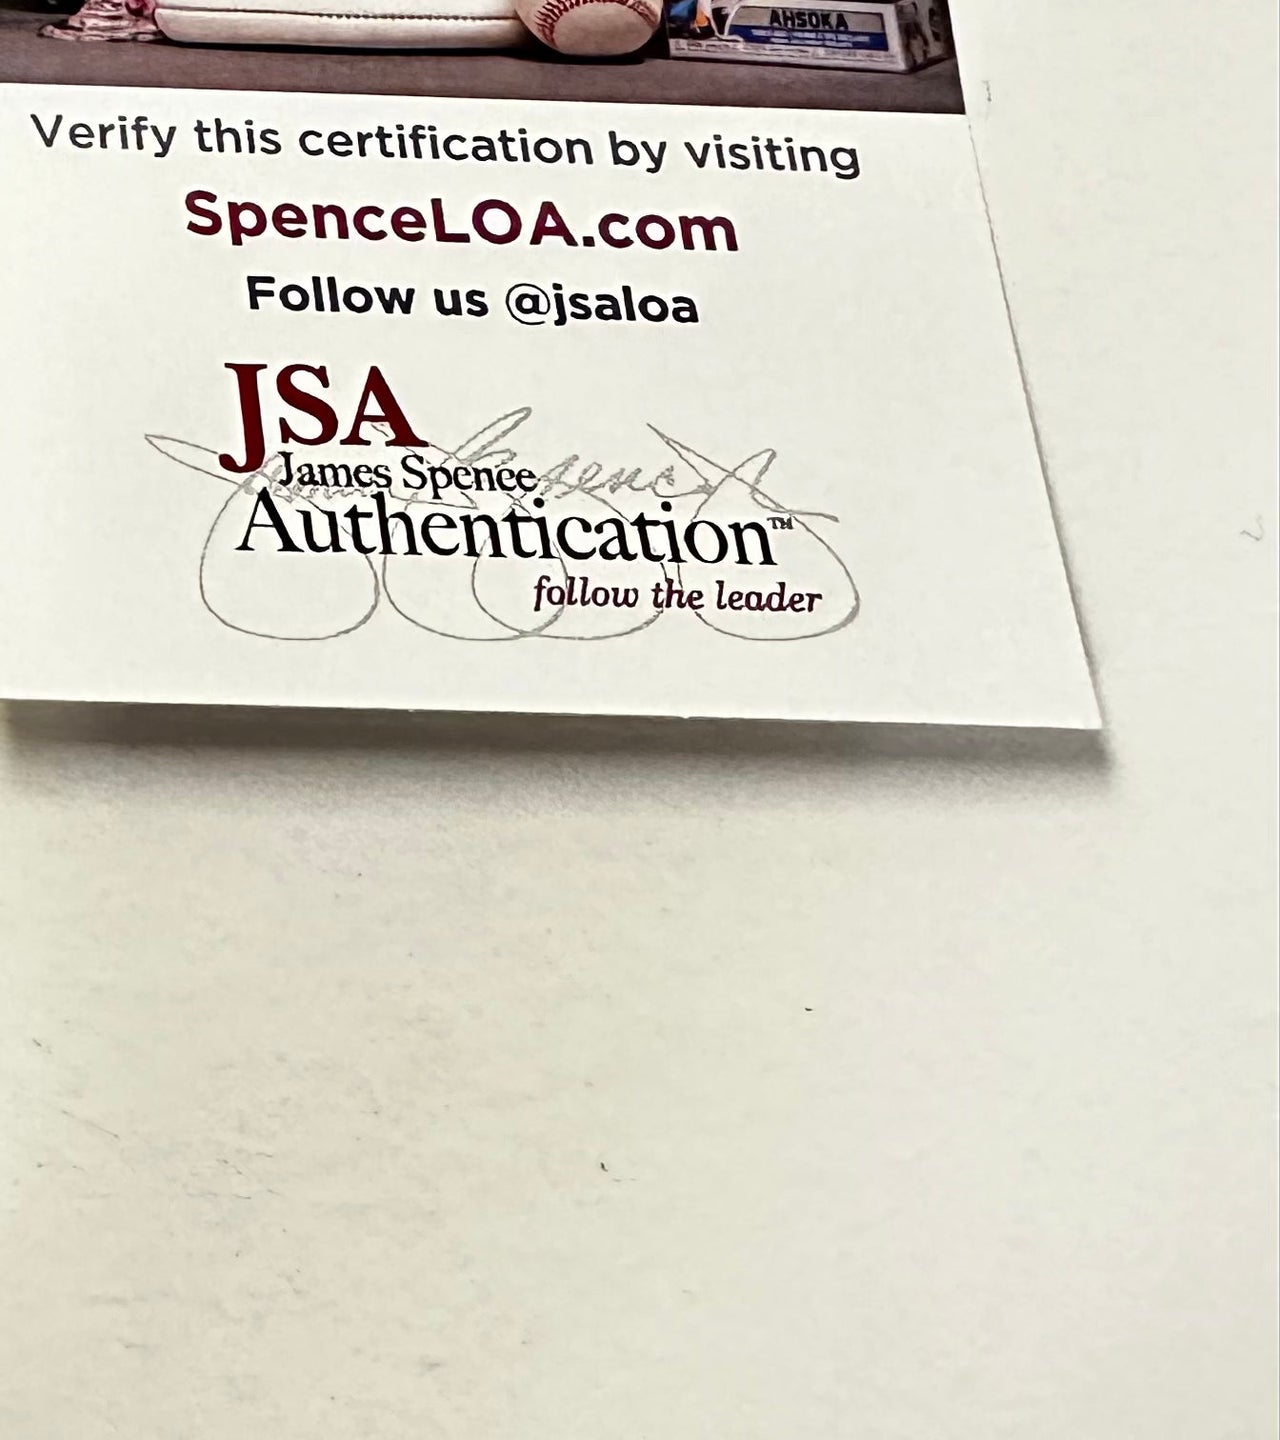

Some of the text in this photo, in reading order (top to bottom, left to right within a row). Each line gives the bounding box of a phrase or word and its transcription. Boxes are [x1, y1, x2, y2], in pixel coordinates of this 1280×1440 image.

[769, 9, 849, 30] AHSOKA
[30, 113, 861, 180] Verify this certification by visiting
[184, 189, 739, 253] SpenceLOA.com
[246, 274, 700, 328] Follow us @jsaloa
[218, 362, 429, 472] JSA
[276, 450, 393, 491] James
[533, 575, 824, 615] follow the leader
